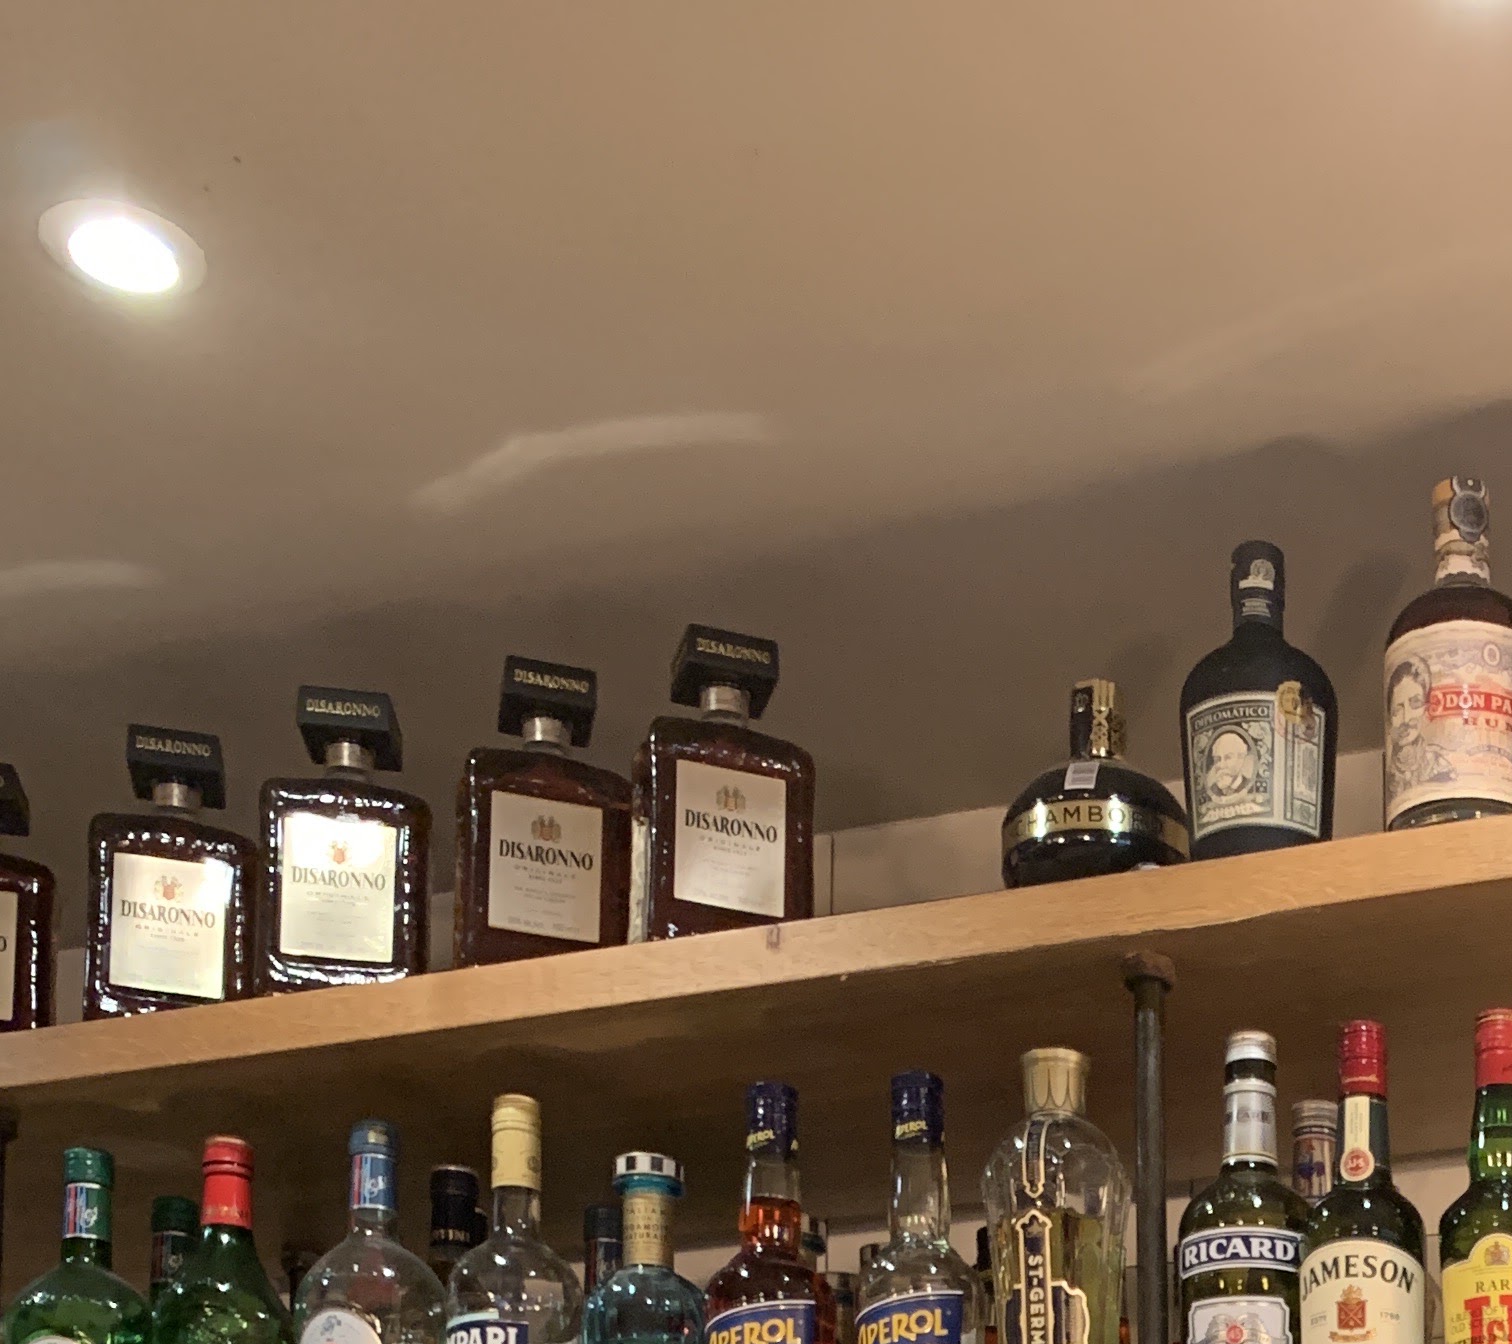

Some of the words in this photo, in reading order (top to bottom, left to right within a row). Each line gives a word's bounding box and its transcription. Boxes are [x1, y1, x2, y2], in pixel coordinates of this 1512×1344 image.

[696, 637, 772, 666] DISARONNO
[513, 668, 590, 694] DISARONNO
[305, 697, 381, 720] DISARONNO
[1445, 693, 1485, 709] DON
[135, 735, 212, 757] DISARONNO
[685, 808, 778, 844] DISARONNO
[499, 838, 594, 872] DISARONNO
[290, 865, 387, 892] DISARONNO
[120, 898, 217, 930] DISARONNO
[1183, 1236, 1296, 1270] RICARD
[1301, 1253, 1416, 1302] JAMESON
